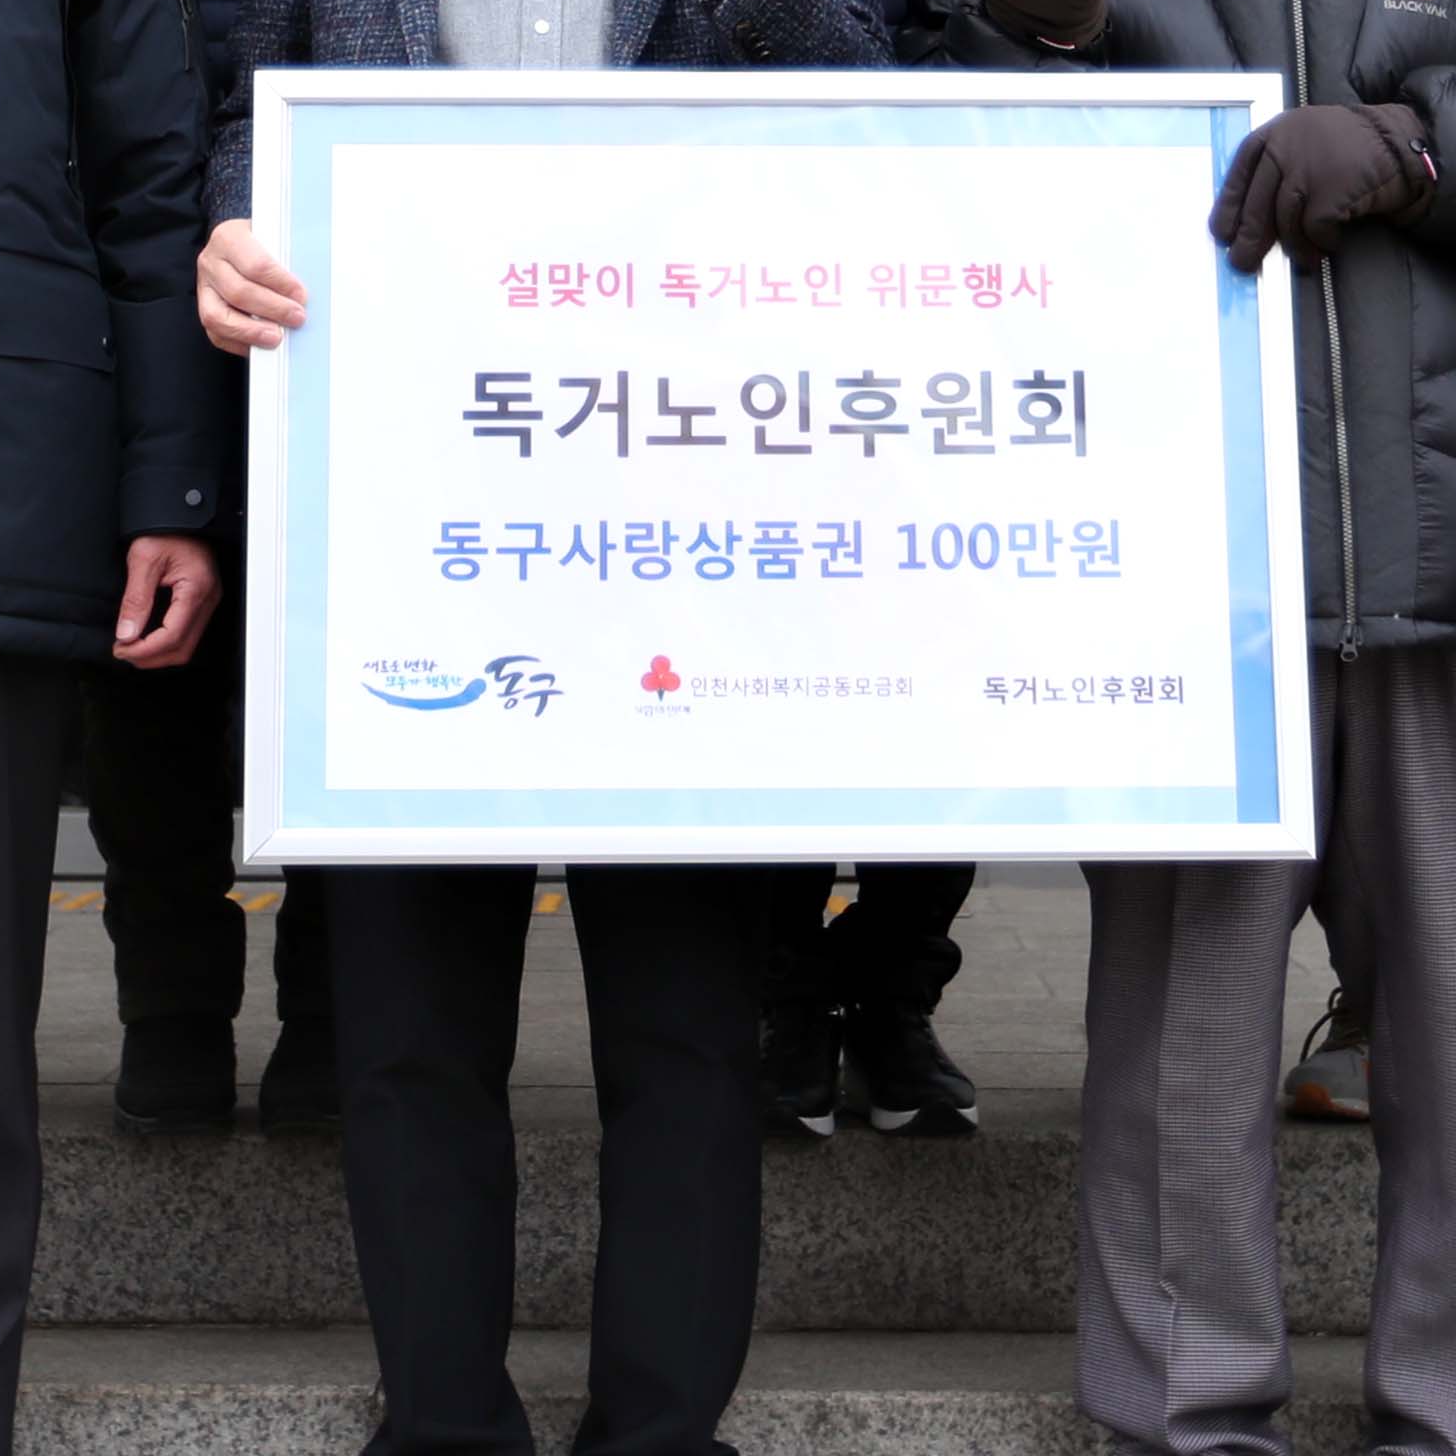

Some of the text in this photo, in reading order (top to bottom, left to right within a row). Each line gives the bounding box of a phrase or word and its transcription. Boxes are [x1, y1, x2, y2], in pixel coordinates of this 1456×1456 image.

[1383, 0, 1449, 19] BLACK YAK
[498, 261, 1053, 310] 설맞이 독거노인 위문행사
[461, 368, 1089, 459] 독거노인후원회
[431, 519, 1123, 582] 동구사랑상품권 100만원
[485, 654, 565, 718] 동구
[690, 675, 914, 698] 인천사회복지공동모금회
[982, 674, 1186, 706] 독거노인후원회
